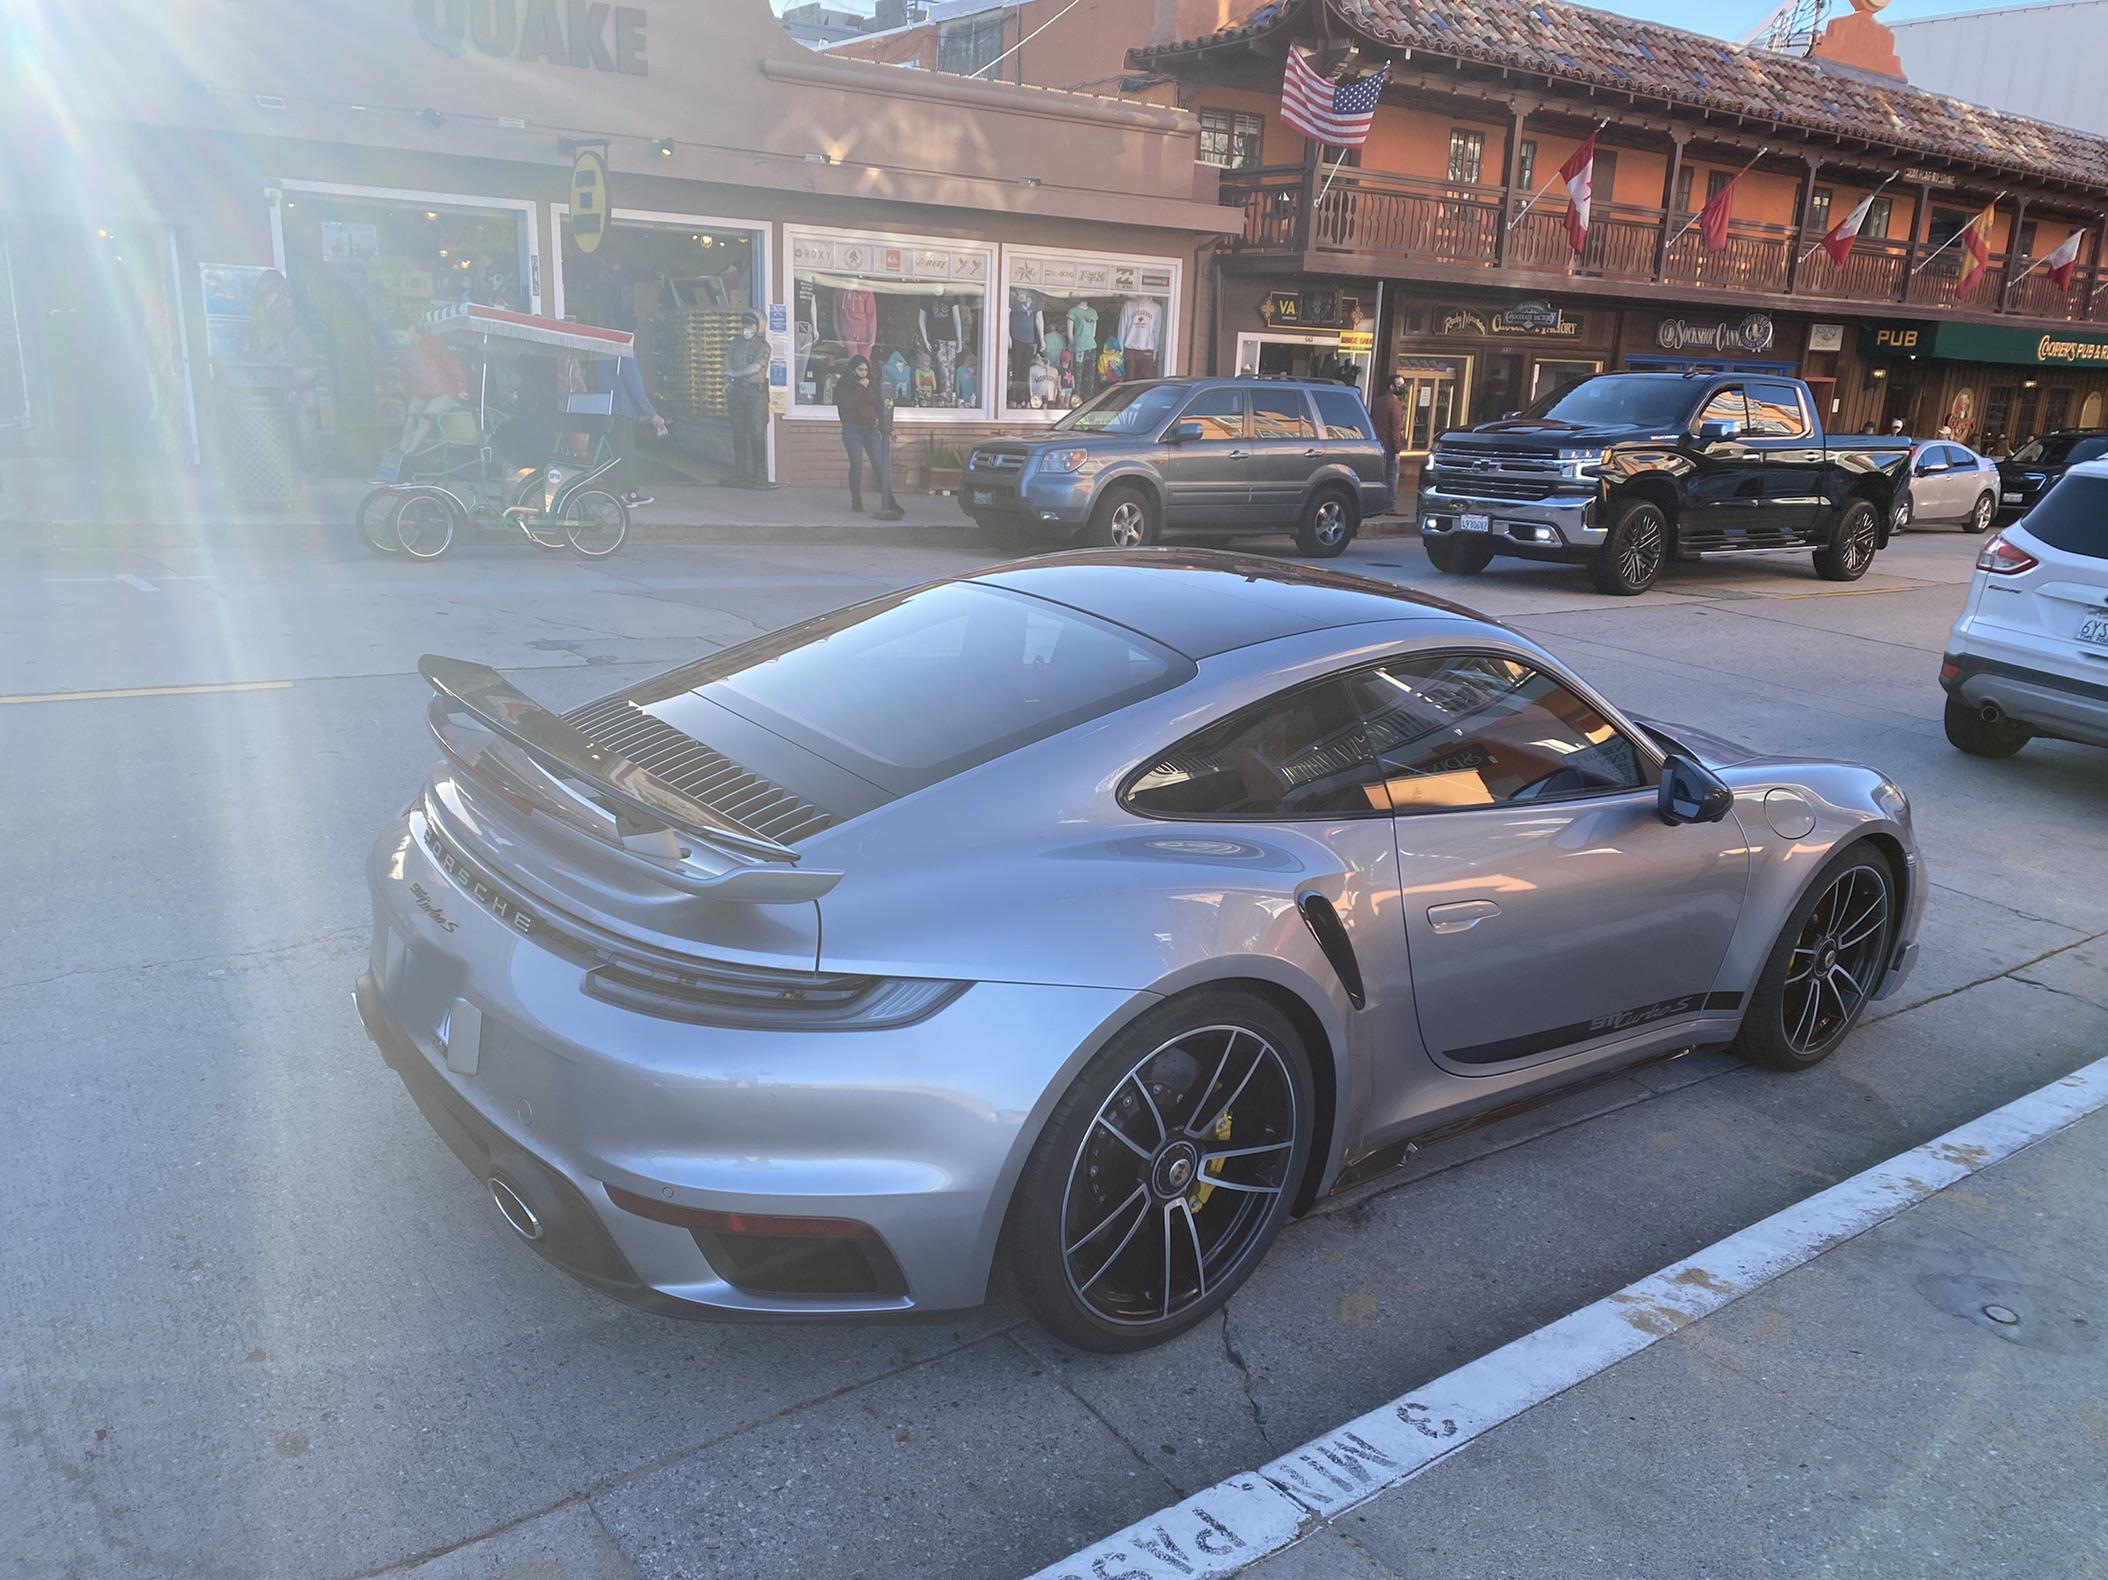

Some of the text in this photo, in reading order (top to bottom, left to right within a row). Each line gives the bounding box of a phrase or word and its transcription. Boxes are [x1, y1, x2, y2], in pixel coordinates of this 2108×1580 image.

[411, 0, 649, 76] QUAKE
[804, 249, 832, 260] ROXY
[1876, 329, 1919, 348] PUB
[2075, 343, 2095, 359] PUB
[424, 828, 532, 933] PORSCHE
[1396, 1402, 1458, 1439] 3
